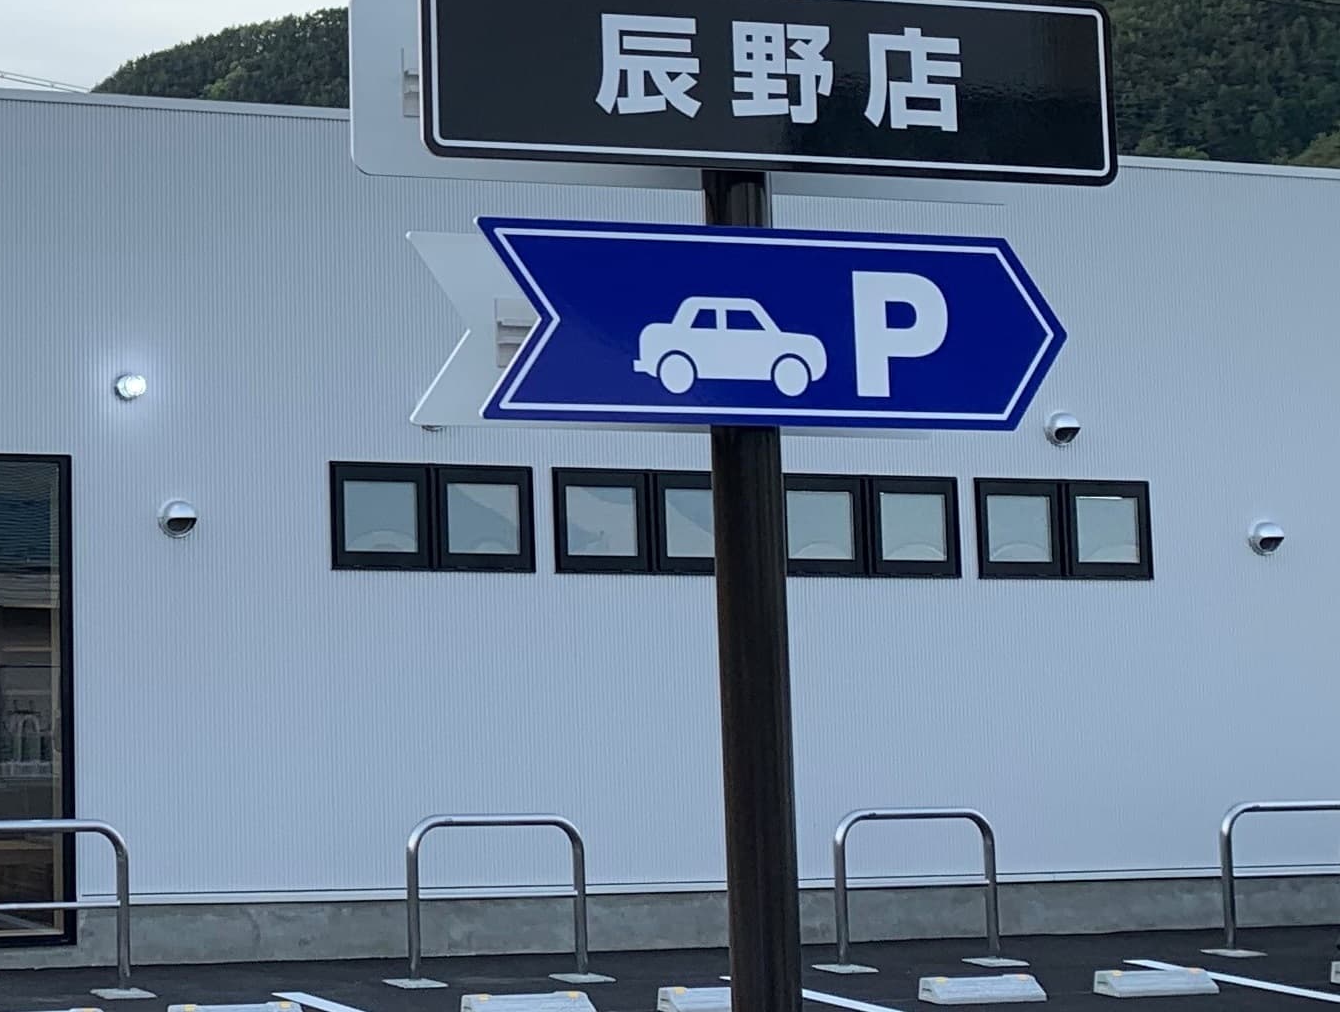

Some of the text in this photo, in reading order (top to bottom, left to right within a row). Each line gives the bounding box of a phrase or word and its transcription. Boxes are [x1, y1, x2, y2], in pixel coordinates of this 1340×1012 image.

[595, 12, 963, 132] 辰野店
[852, 270, 949, 398] P
